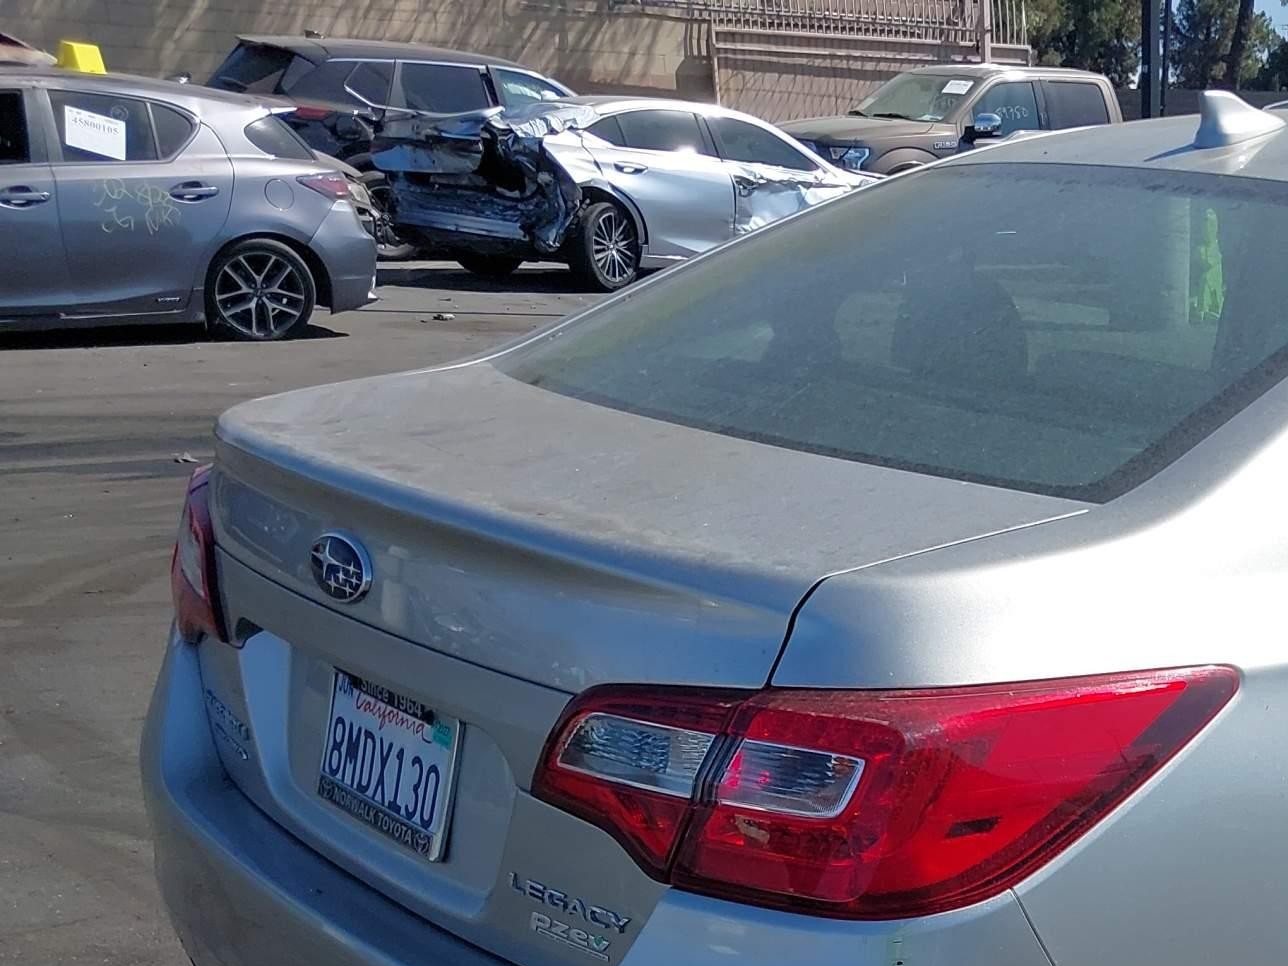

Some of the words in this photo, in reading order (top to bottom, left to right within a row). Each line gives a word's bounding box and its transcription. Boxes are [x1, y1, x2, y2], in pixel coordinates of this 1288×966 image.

[354, 690, 432, 743] California
[361, 678, 389, 702] Since
[393, 693, 422, 717] 1964
[328, 716, 440, 829] 8MDX130
[332, 784, 378, 824] NORWALK
[378, 811, 413, 845] TOYOTA
[508, 871, 633, 933] LEGACY
